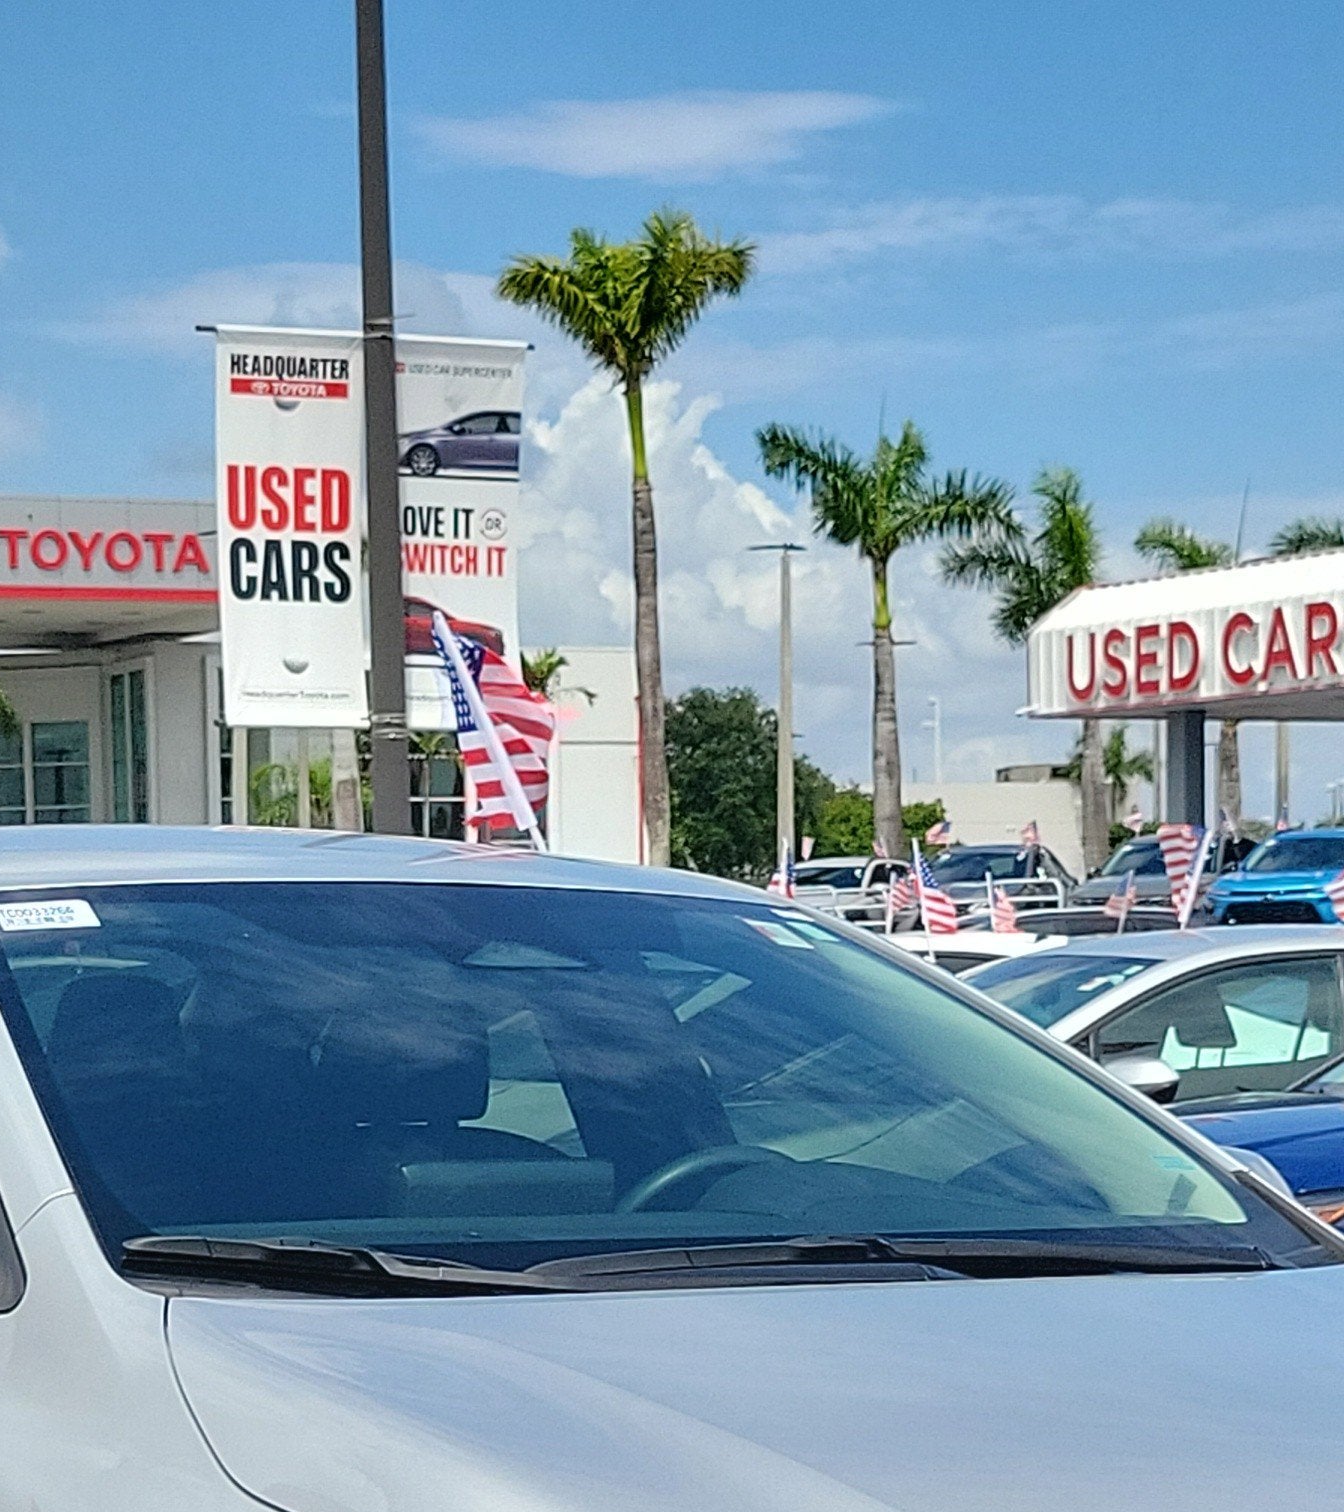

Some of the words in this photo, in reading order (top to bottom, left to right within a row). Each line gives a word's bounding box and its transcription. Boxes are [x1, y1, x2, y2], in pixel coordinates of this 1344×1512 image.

[230, 353, 349, 380] HEADQUARTER
[272, 382, 327, 398] TOYOTA
[227, 465, 351, 533] USED
[403, 506, 444, 537] OVE
[453, 507, 474, 539] IT
[484, 518, 502, 531] OR
[229, 537, 351, 602] CARS
[402, 543, 477, 576] WITCH
[486, 546, 506, 577] IT
[1067, 621, 1200, 702] USED
[1222, 602, 1339, 687] CAR
